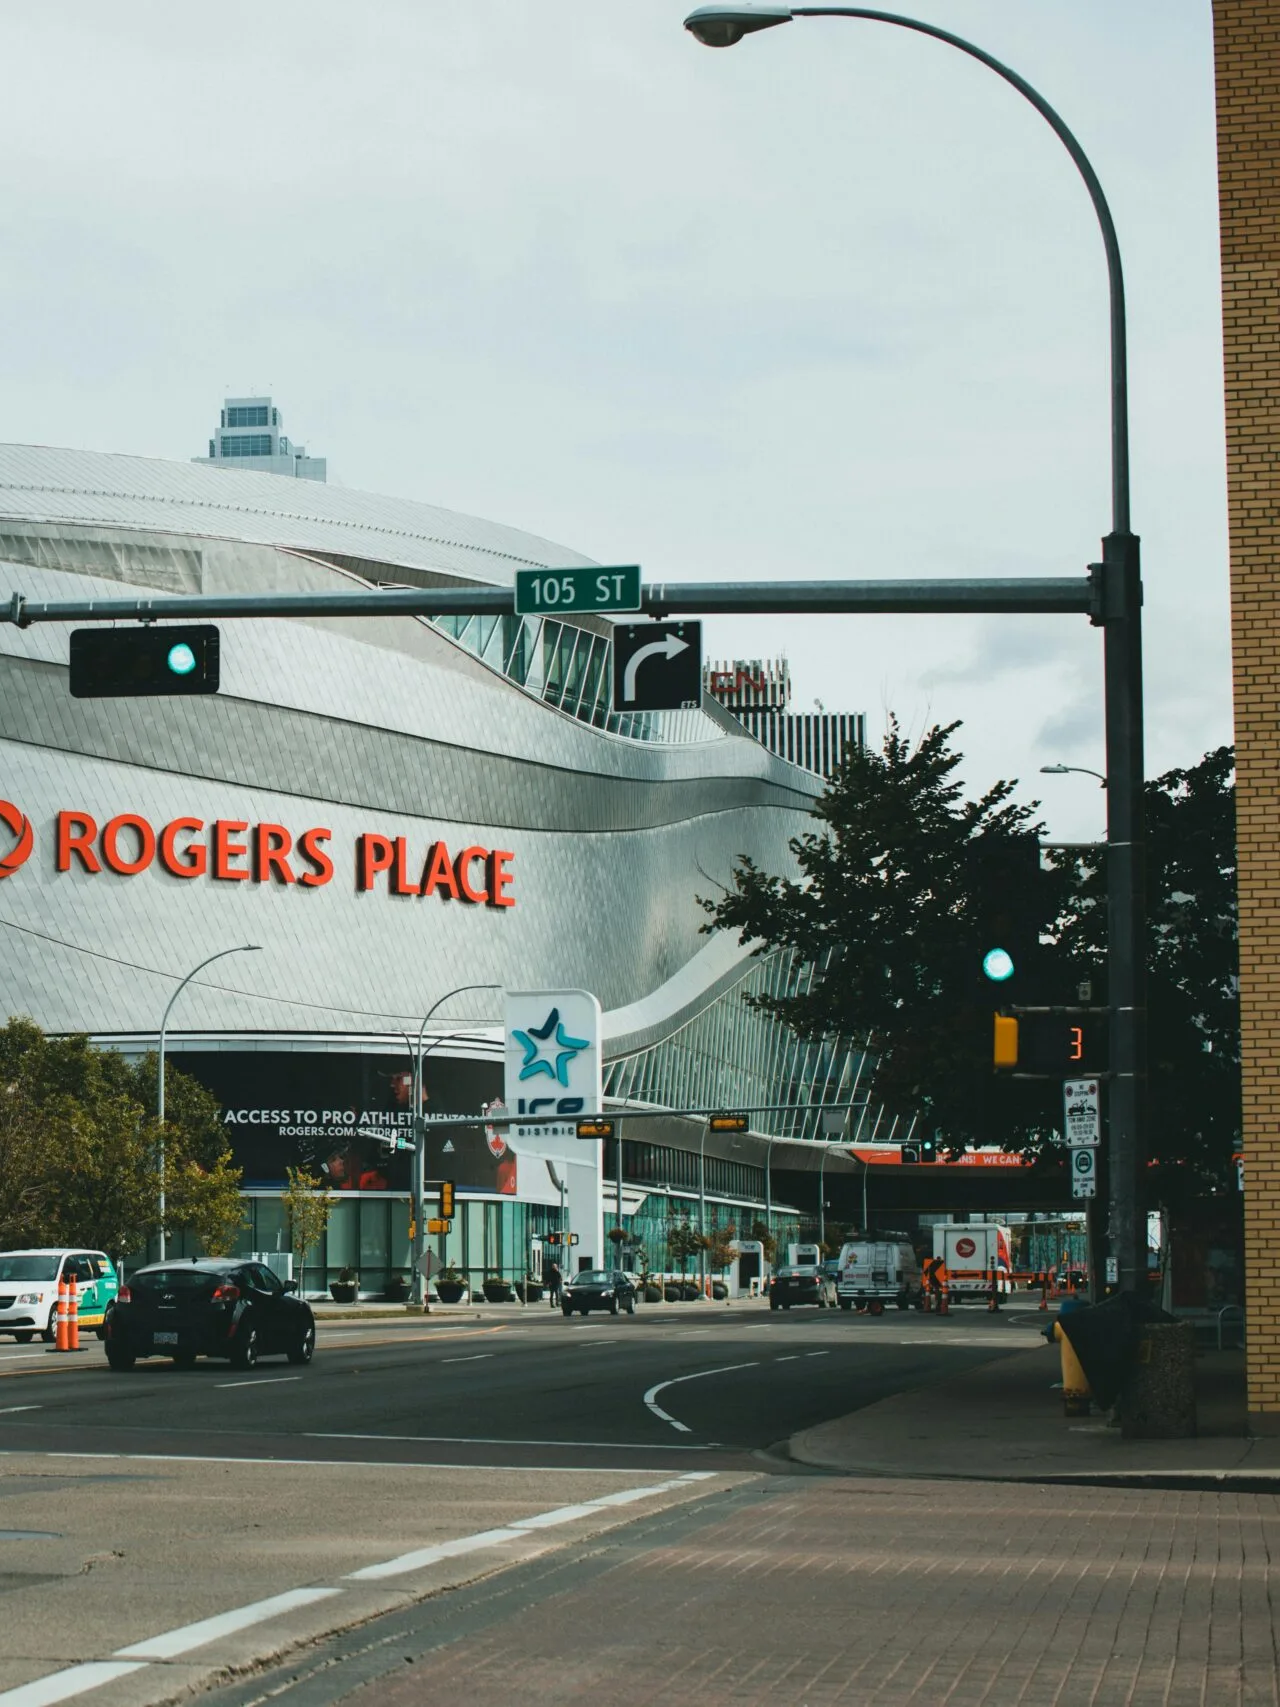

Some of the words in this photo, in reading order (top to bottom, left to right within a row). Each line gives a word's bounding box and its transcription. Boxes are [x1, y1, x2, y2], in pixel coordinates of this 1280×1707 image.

[530, 577, 576, 605] 105
[595, 574, 626, 602] ST
[711, 671, 765, 692] CN
[680, 700, 697, 709] ETS
[56, 811, 335, 887] ROGERS
[361, 832, 516, 907] PLACE
[1070, 1027, 1083, 1060] 3
[223, 1109, 291, 1124] ACCESS
[293, 1110, 318, 1124] TO
[322, 1110, 356, 1125] PRO
[359, 1111, 414, 1126] ATHLET
[517, 1127, 575, 1137] DISTRIC
[983, 1155, 998, 1164] WE
